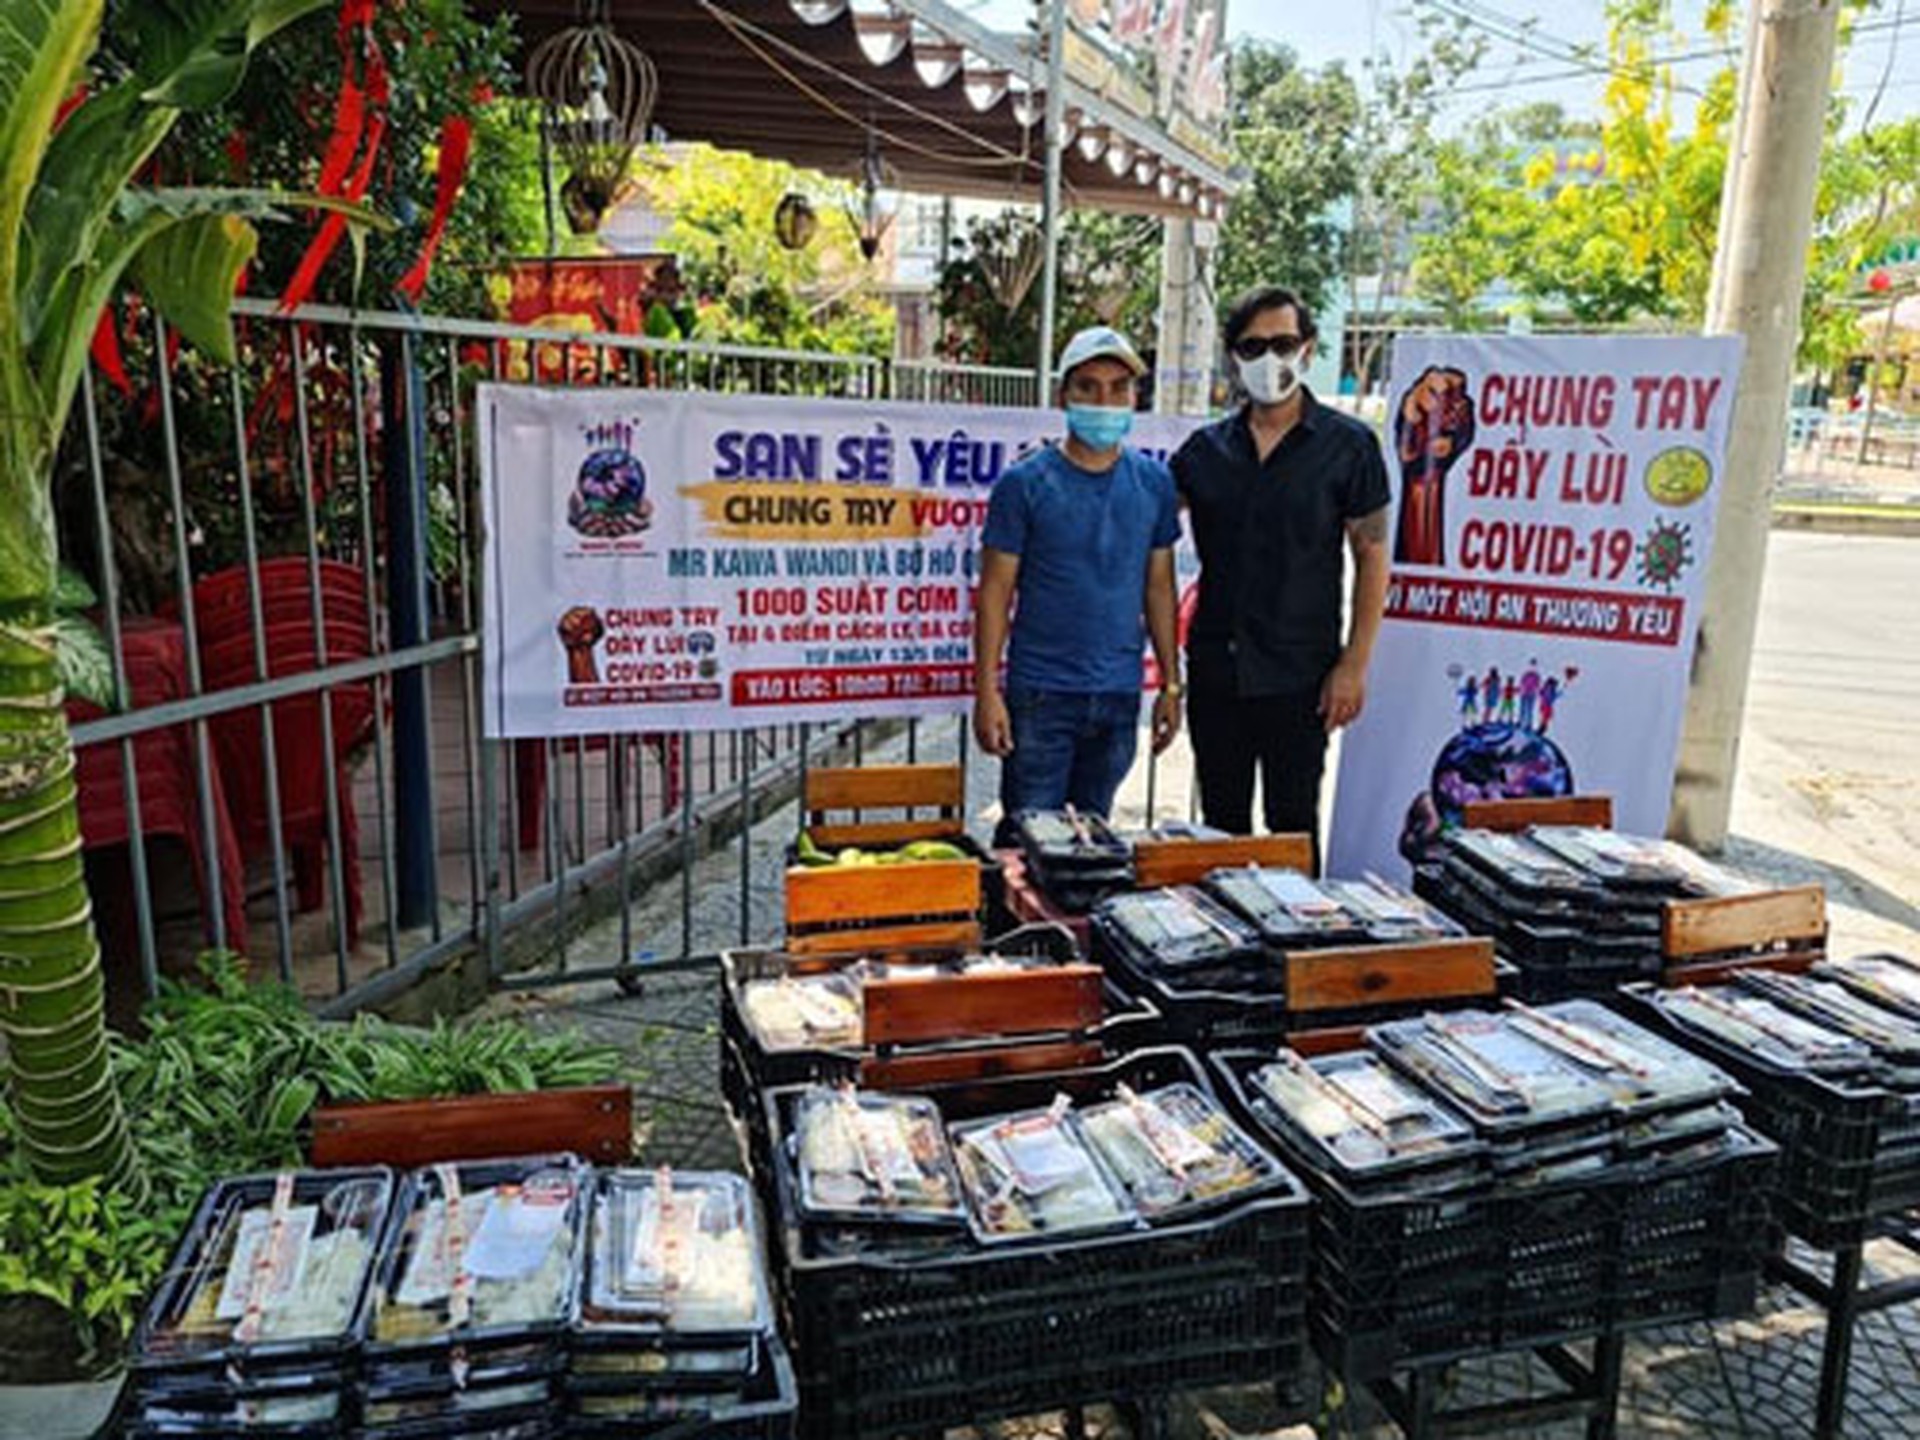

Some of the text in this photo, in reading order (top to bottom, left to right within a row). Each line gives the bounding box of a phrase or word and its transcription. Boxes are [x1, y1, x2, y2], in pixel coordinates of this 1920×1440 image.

[1480, 373, 1721, 431] CHUNG TAY
[714, 431, 821, 481] SAN
[909, 430, 1003, 486] YÊU
[1468, 426, 1627, 505] ĐẨY LÙI
[724, 496, 831, 525] CHUNG
[843, 497, 896, 526] TAY
[668, 548, 706, 578] MR
[713, 547, 776, 577] KAWA
[1459, 519, 1633, 580] COVID-19
[606, 607, 719, 628] CHUNG TAY
[737, 587, 806, 616] 1000
[897, 584, 957, 614] CƠM
[1497, 595, 1526, 622] AN
[1627, 600, 1673, 636] YÊU
